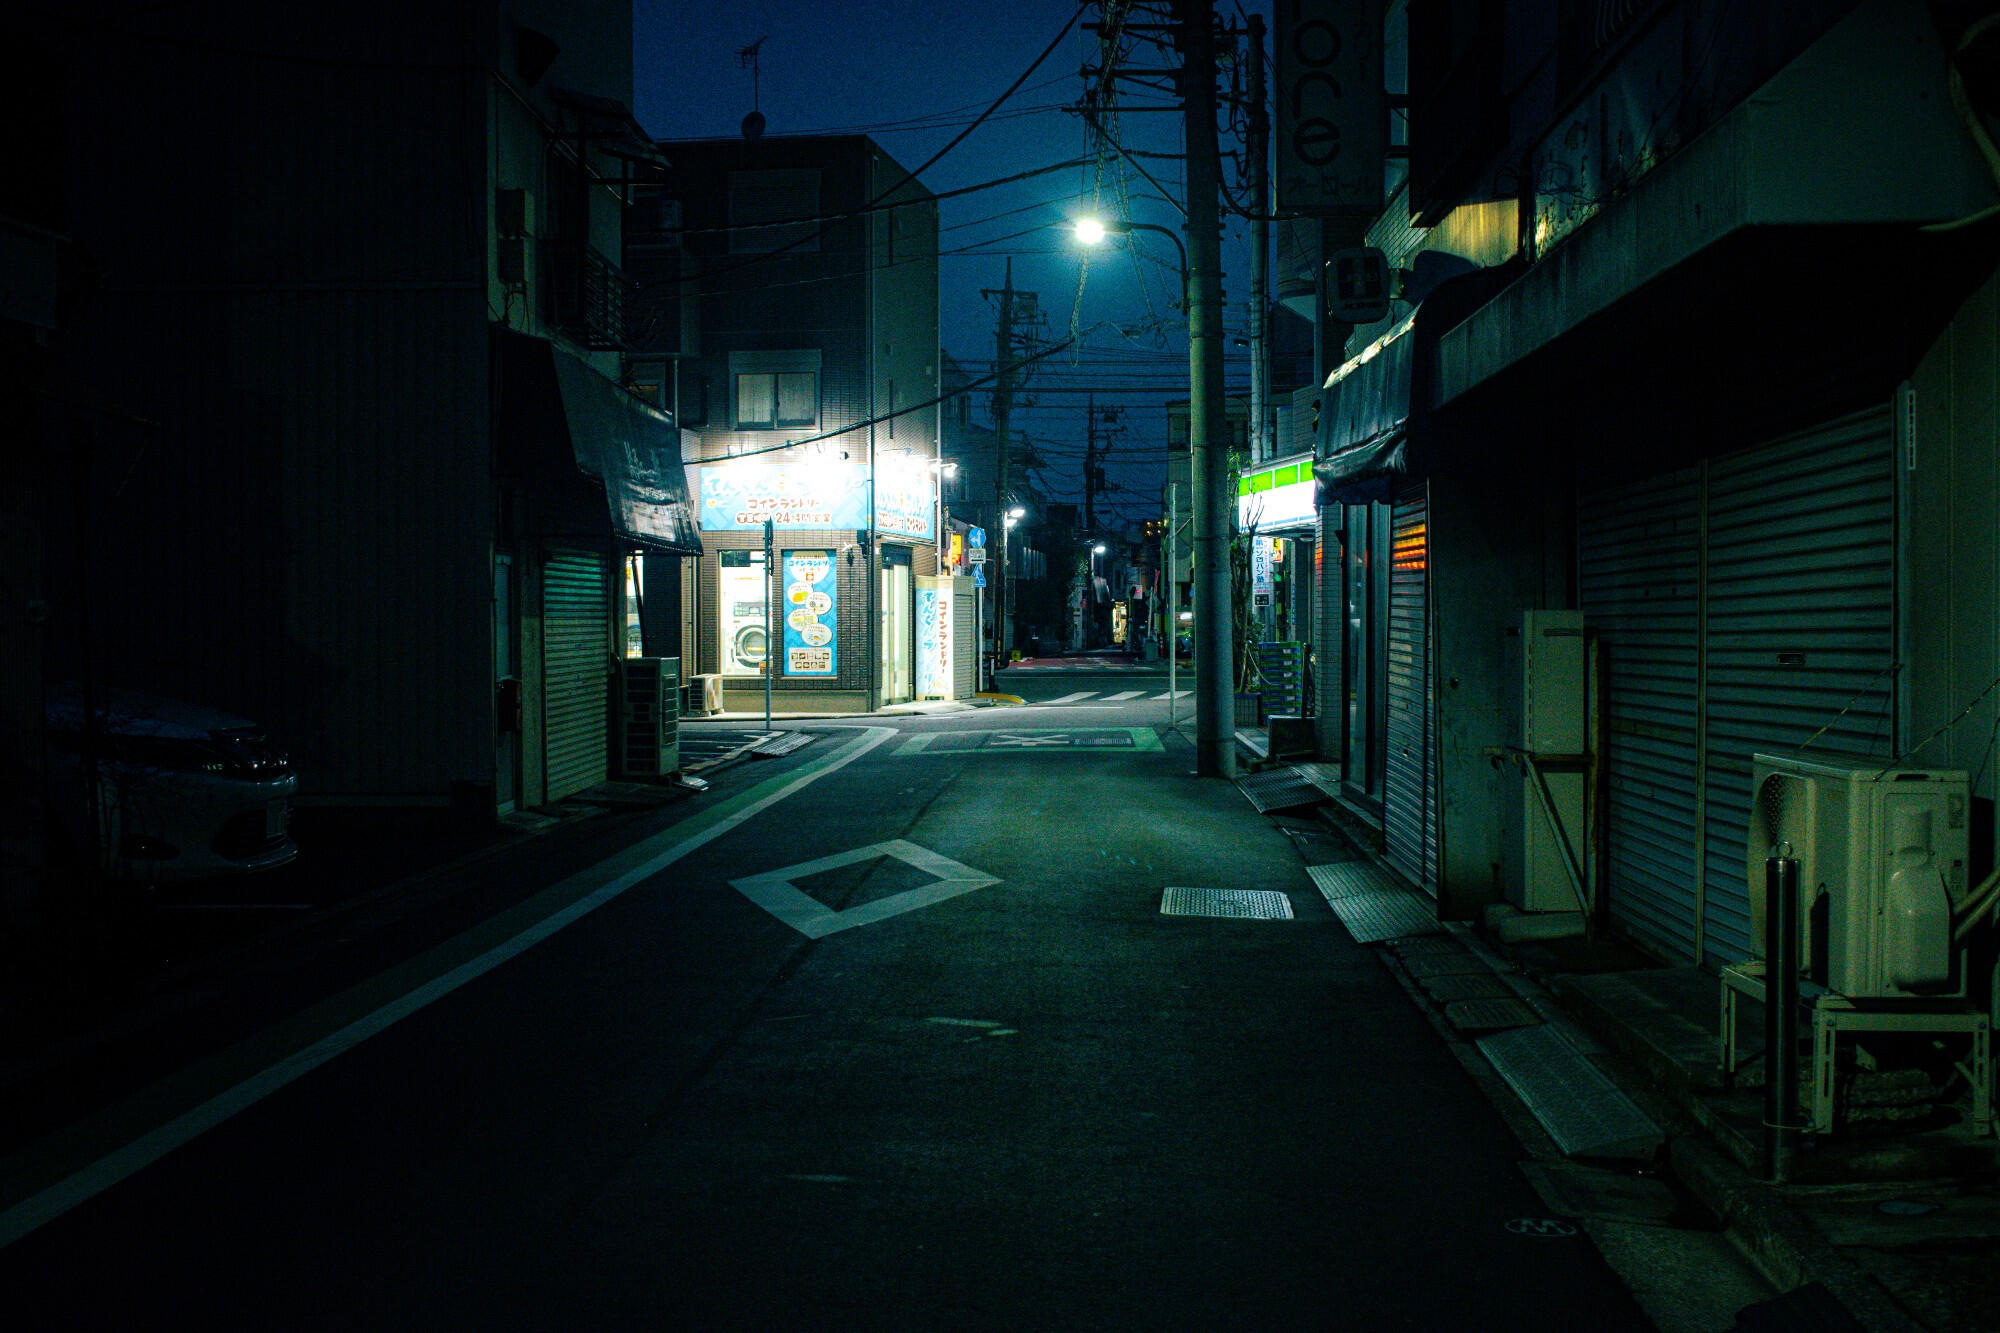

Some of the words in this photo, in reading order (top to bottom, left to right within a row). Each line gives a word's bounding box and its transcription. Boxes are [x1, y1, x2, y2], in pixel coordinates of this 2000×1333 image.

[747, 498, 820, 509] コインランドリー
[938, 601, 948, 673] コインランドリー
